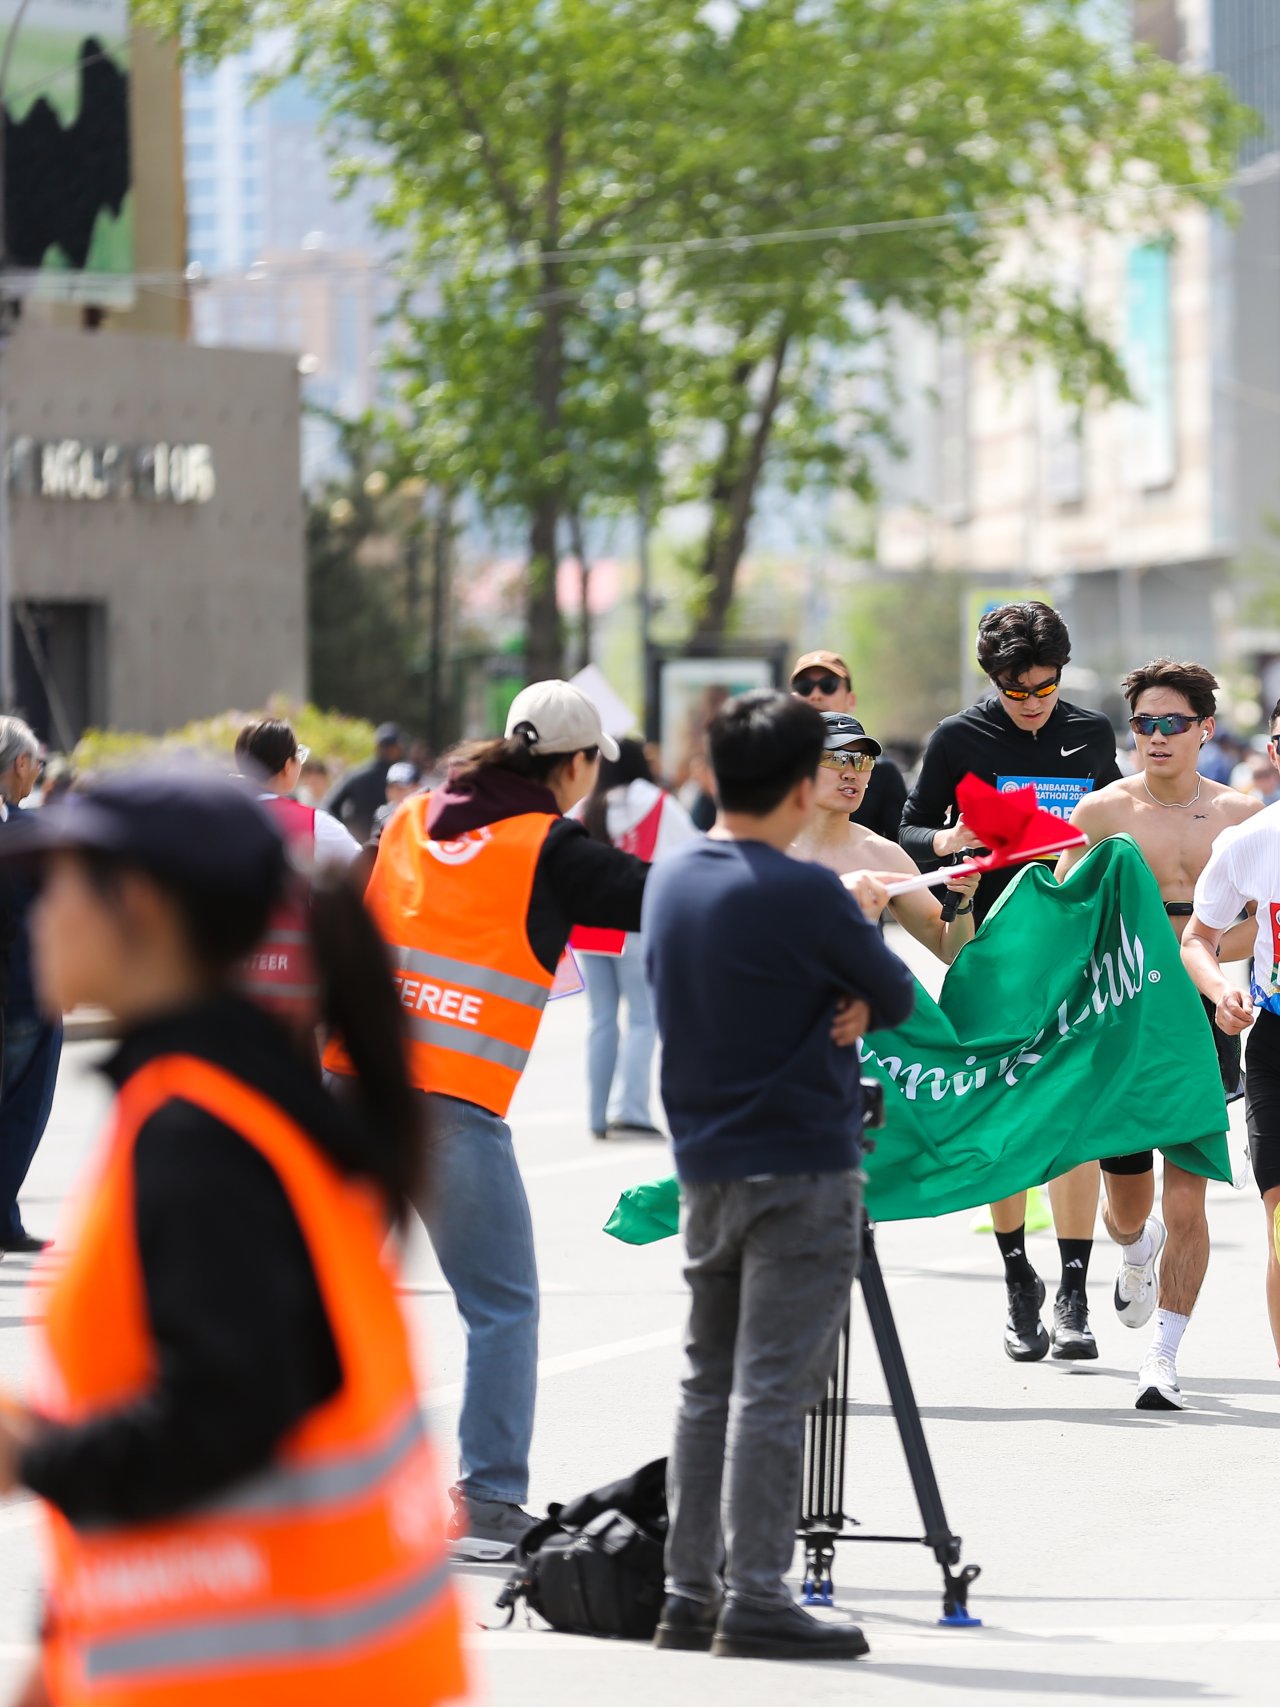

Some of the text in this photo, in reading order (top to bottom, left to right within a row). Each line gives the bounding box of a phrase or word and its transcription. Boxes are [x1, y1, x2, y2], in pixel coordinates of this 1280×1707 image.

[1021, 782, 1081, 792] UANBAATAR
[1035, 791, 1069, 801] RATHON
[393, 976, 483, 1026] EREE
